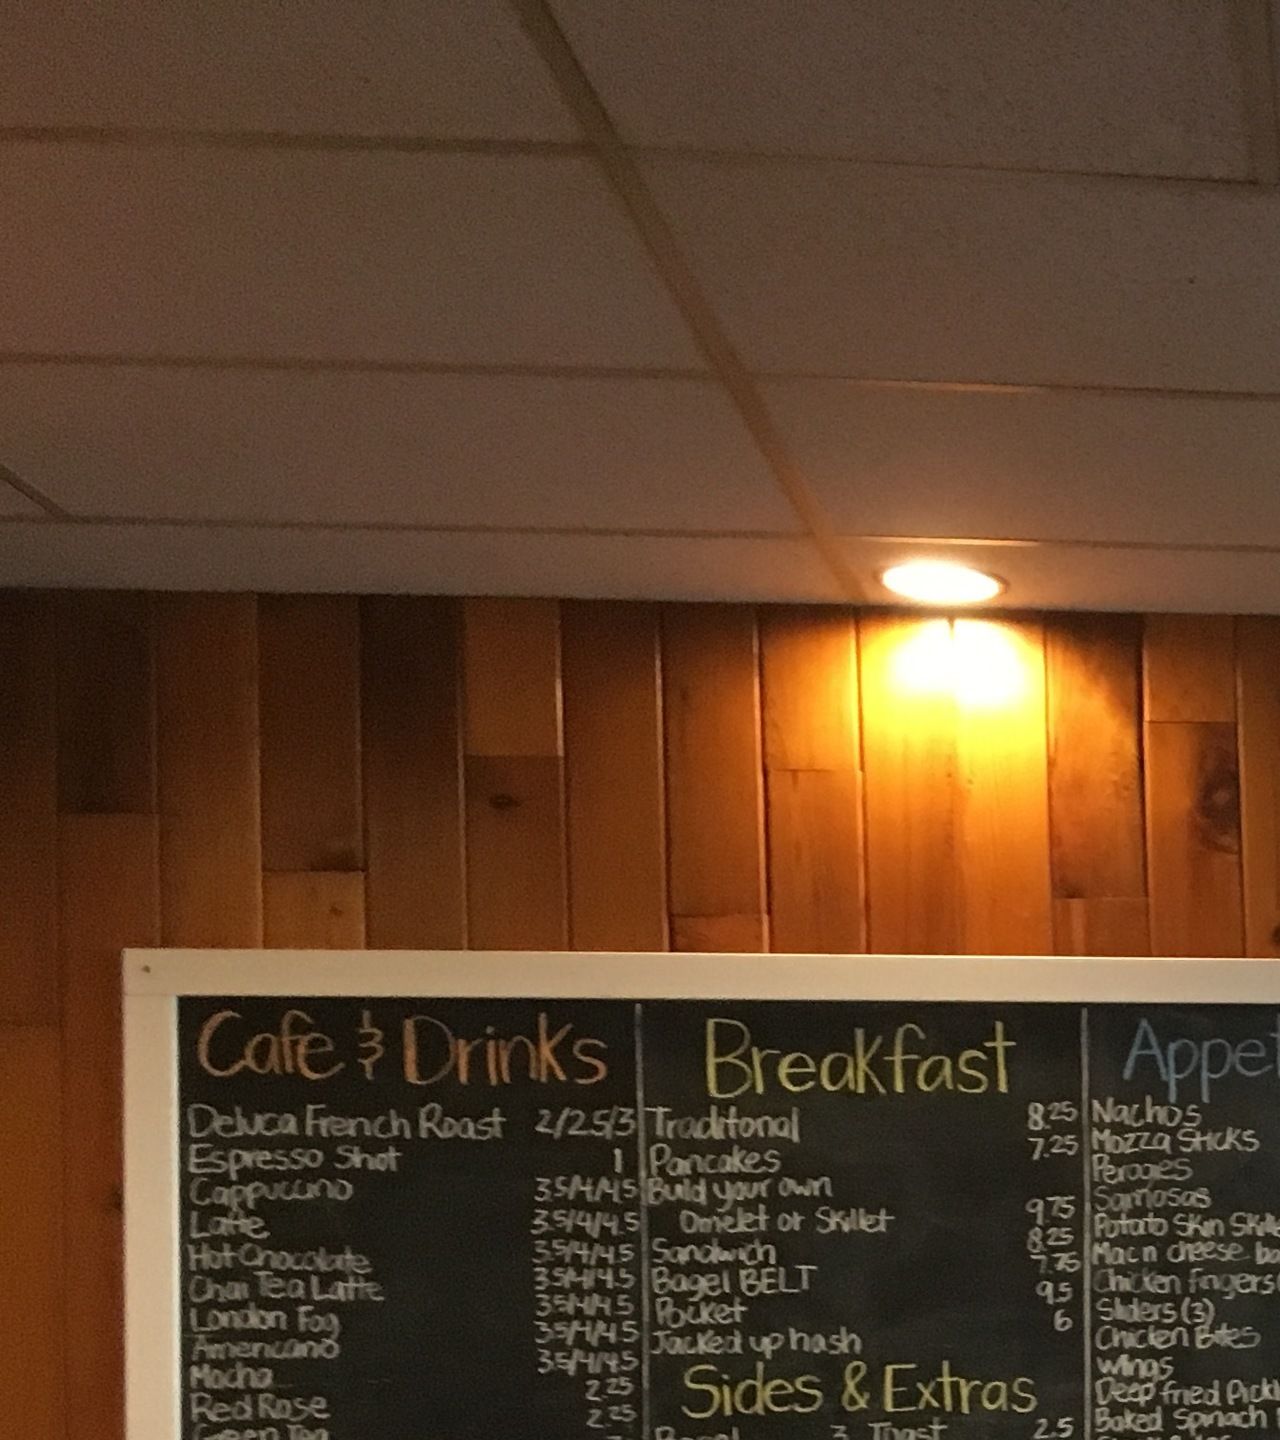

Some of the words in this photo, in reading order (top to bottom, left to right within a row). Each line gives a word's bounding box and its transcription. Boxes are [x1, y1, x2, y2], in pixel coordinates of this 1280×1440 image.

[199, 1010, 345, 1080] Cafe
[357, 1010, 384, 1080] &
[403, 1013, 608, 1085] Drinks
[705, 1018, 1016, 1098] Breakfast
[305, 1104, 411, 1138] French
[419, 1103, 506, 1139] Roast
[1091, 1095, 1202, 1127] Nachos
[188, 1144, 324, 1180] Espresso
[335, 1145, 402, 1171] Shot
[613, 1148, 623, 1173] 1
[649, 1143, 781, 1176] Pancakes
[646, 1178, 708, 1204] Build
[712, 1181, 770, 1212] your
[779, 1177, 833, 1197] own
[1093, 1187, 1213, 1212] Samosas
[778, 1210, 804, 1233] or
[815, 1206, 895, 1233] Skillet
[1093, 1215, 1168, 1239] Potato
[188, 1245, 232, 1272] Hot
[651, 1238, 777, 1265] Sandwich
[1092, 1243, 1138, 1265] Mac
[254, 1271, 305, 1299] Tea
[310, 1276, 385, 1301] Latte
[650, 1267, 731, 1300] Bagel
[740, 1264, 818, 1295] BELT
[1095, 1271, 1183, 1295] Chicken
[190, 1302, 286, 1331] London
[296, 1305, 341, 1338] Fog
[655, 1299, 748, 1328] Pocket
[1053, 1309, 1073, 1332] 6
[1096, 1297, 1178, 1324] Sliders
[650, 1325, 743, 1356] Jacked
[750, 1333, 784, 1358] up
[789, 1327, 863, 1354] hash
[1095, 1324, 1190, 1350] Chicken
[1195, 1326, 1261, 1350] Bites
[190, 1362, 273, 1389] Mocha
[681, 1363, 823, 1419] Sides
[842, 1360, 871, 1412] &
[883, 1360, 1038, 1414] Extras
[1096, 1378, 1156, 1407] Deep
[191, 1395, 253, 1422] Red
[258, 1394, 330, 1421] Rose
[1095, 1408, 1163, 1433] Baked
[1174, 1405, 1268, 1430] Spinach
